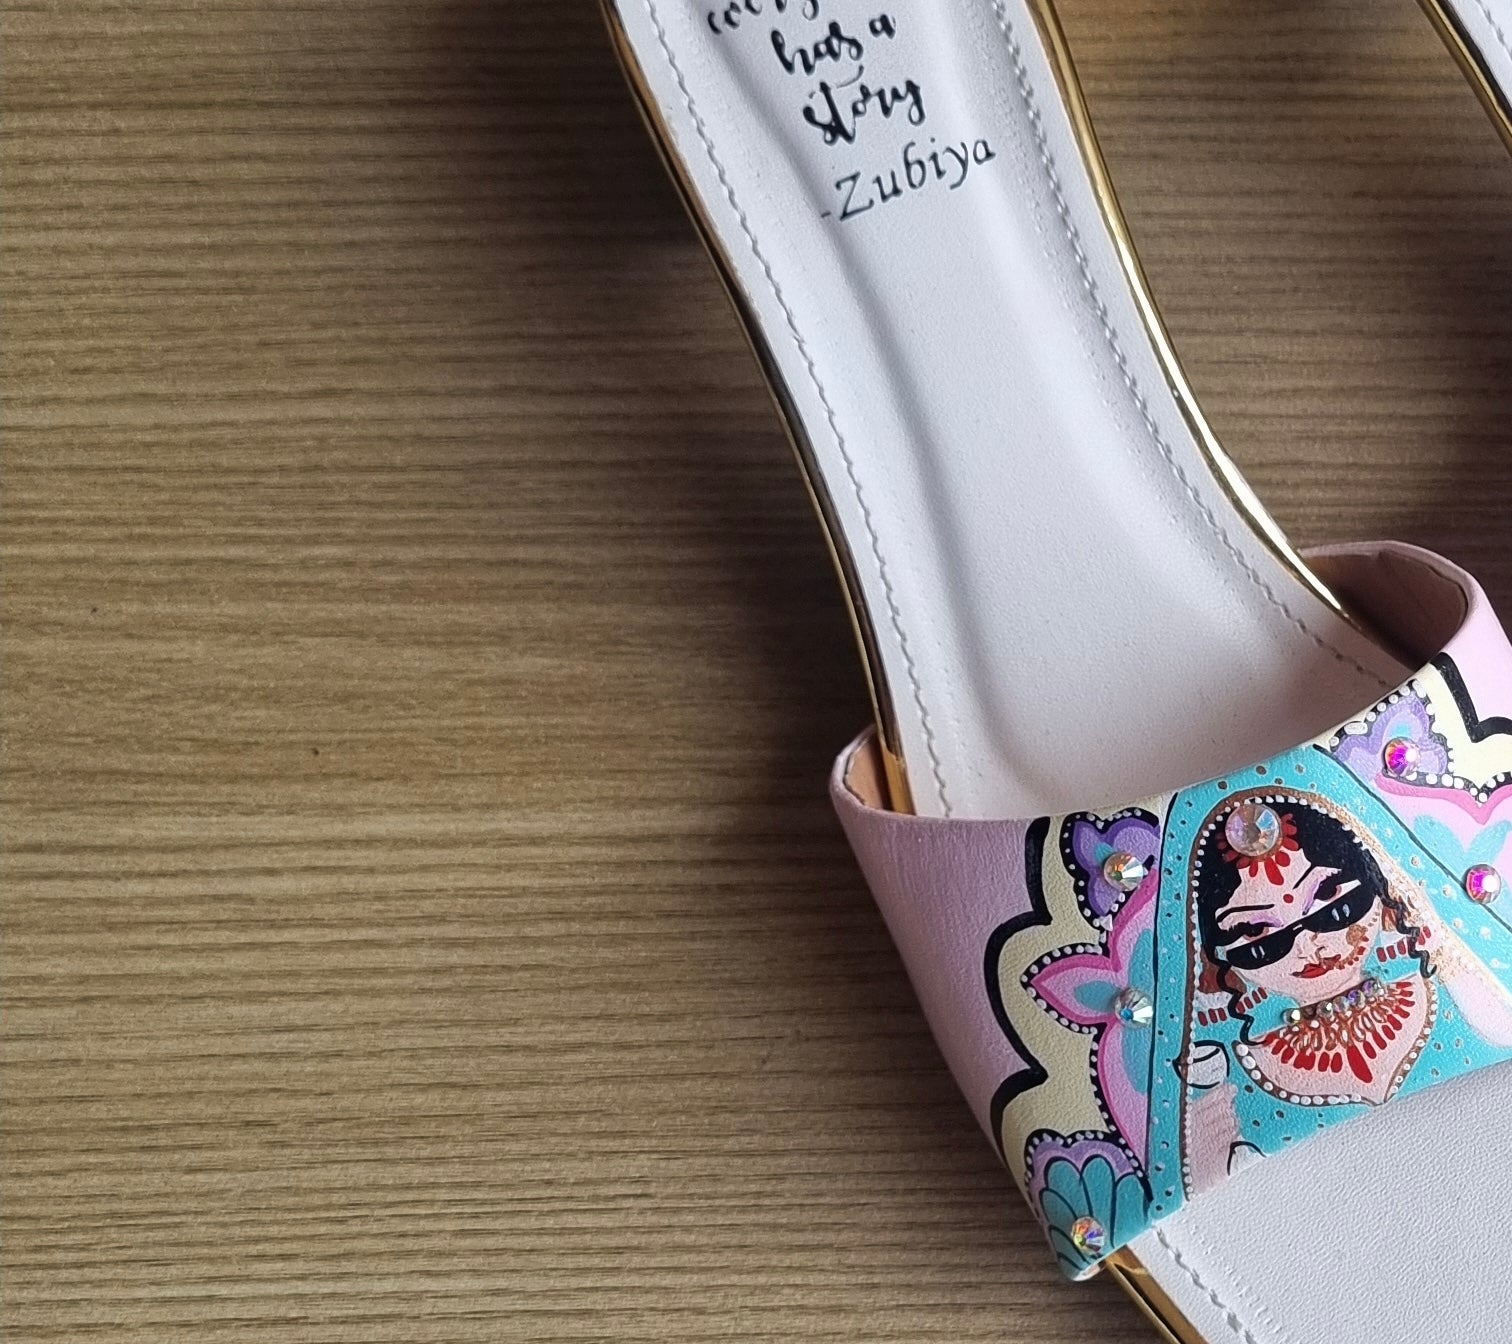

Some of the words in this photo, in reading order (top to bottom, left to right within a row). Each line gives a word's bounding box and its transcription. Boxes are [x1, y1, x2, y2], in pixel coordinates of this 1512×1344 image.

[771, 20, 863, 76] has
[869, 13, 896, 38] a
[803, 65, 925, 146] story
